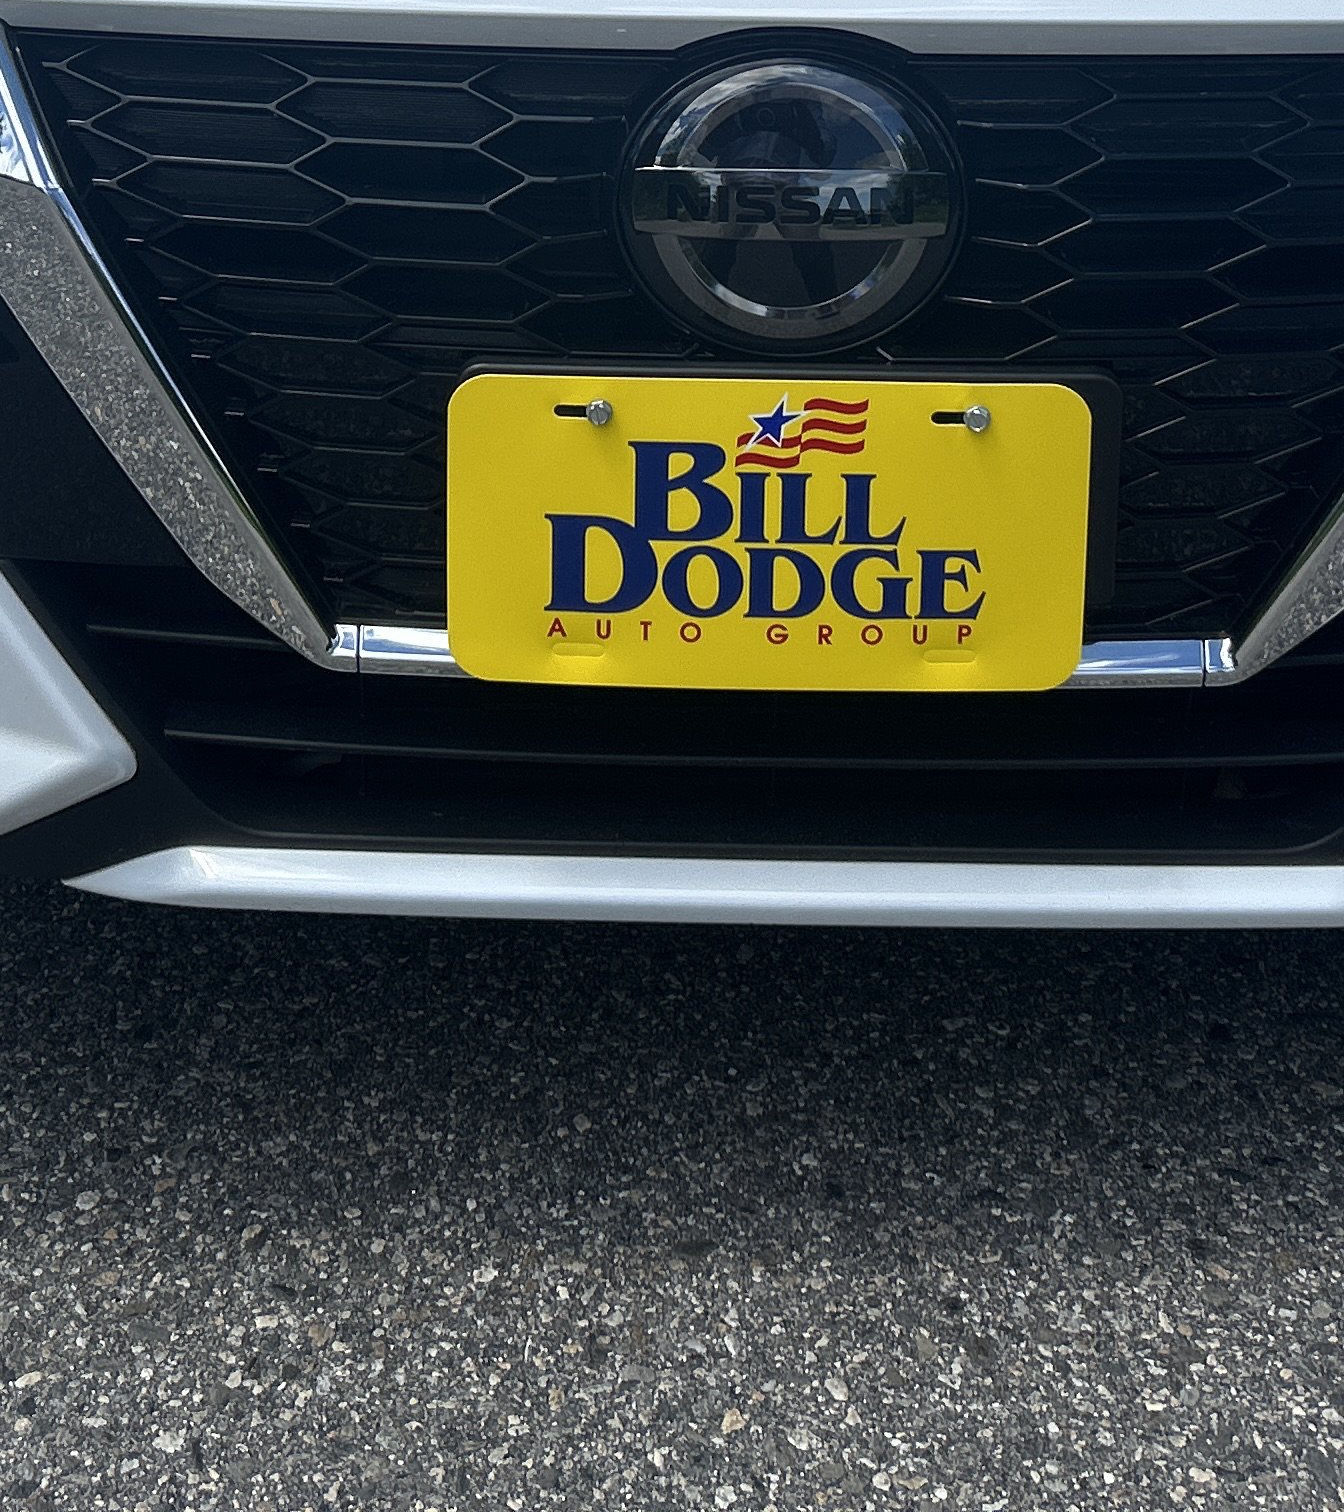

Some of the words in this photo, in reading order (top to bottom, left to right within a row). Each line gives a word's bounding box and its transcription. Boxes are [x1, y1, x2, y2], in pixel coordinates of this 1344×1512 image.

[666, 185, 915, 226] NISSAN
[627, 440, 907, 545] BILL
[543, 513, 987, 621] DODGE
[546, 616, 703, 644] AUTO
[765, 622, 974, 647] GROUP
